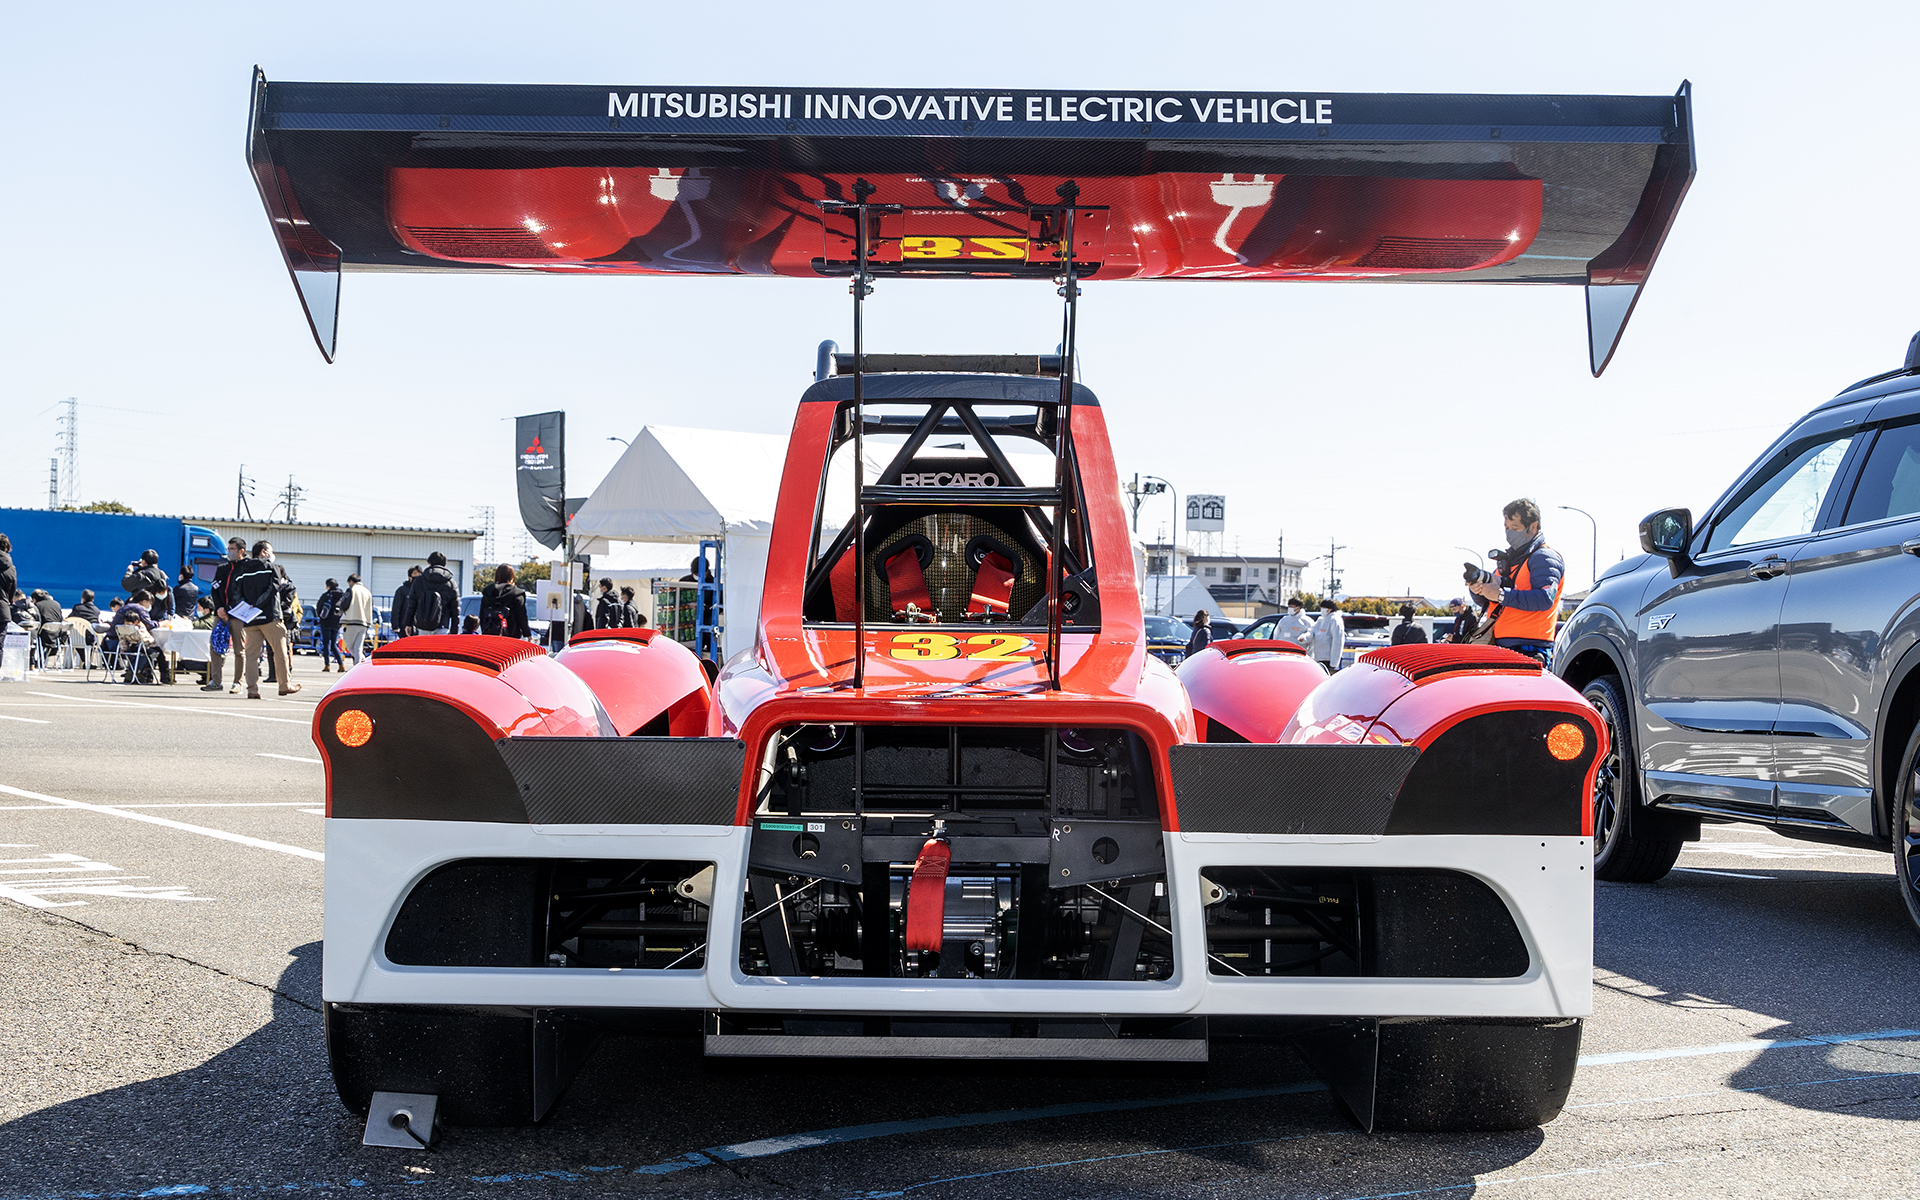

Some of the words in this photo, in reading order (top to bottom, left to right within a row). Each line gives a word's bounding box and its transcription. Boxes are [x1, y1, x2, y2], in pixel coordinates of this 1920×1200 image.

[608, 92, 792, 119] MITSUBISHI
[804, 93, 1013, 122] INNOVATIVE
[1025, 96, 1183, 124] ELECTRIC
[1190, 98, 1333, 126] VEHICLE
[900, 472, 1000, 487] RECARO
[1648, 618, 1672, 631] EV
[889, 633, 1034, 662] 32
[1052, 828, 1061, 842] R
